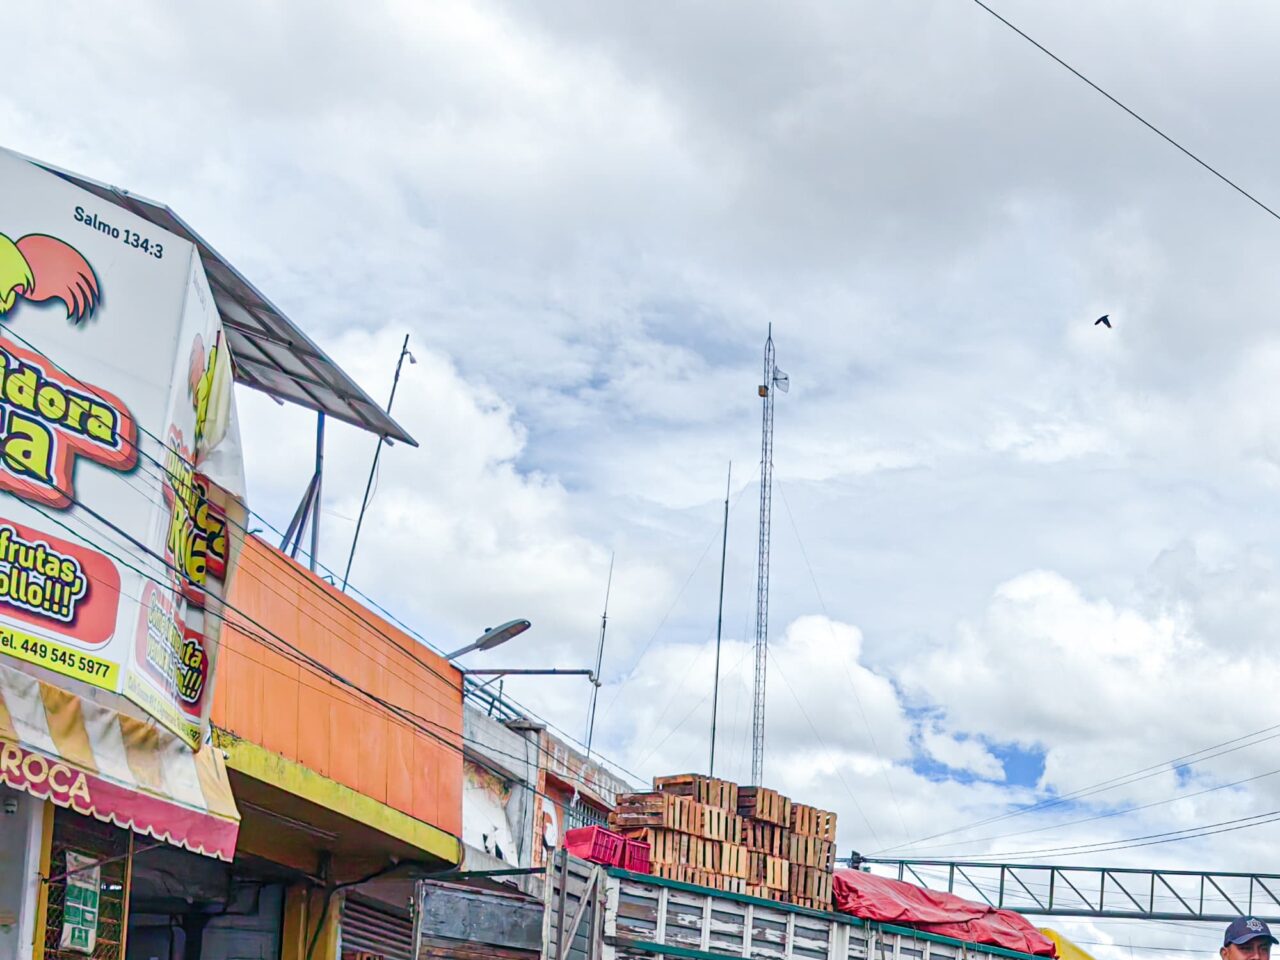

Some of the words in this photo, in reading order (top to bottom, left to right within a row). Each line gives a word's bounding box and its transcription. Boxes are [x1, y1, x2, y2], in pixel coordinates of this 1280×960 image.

[74, 206, 120, 239] Salmo
[123, 229, 164, 259] 134:3
[21, 639, 48, 659] 449
[50, 647, 76, 669] 545
[78, 656, 110, 679] 5977
[1, 742, 91, 803] ROCA
